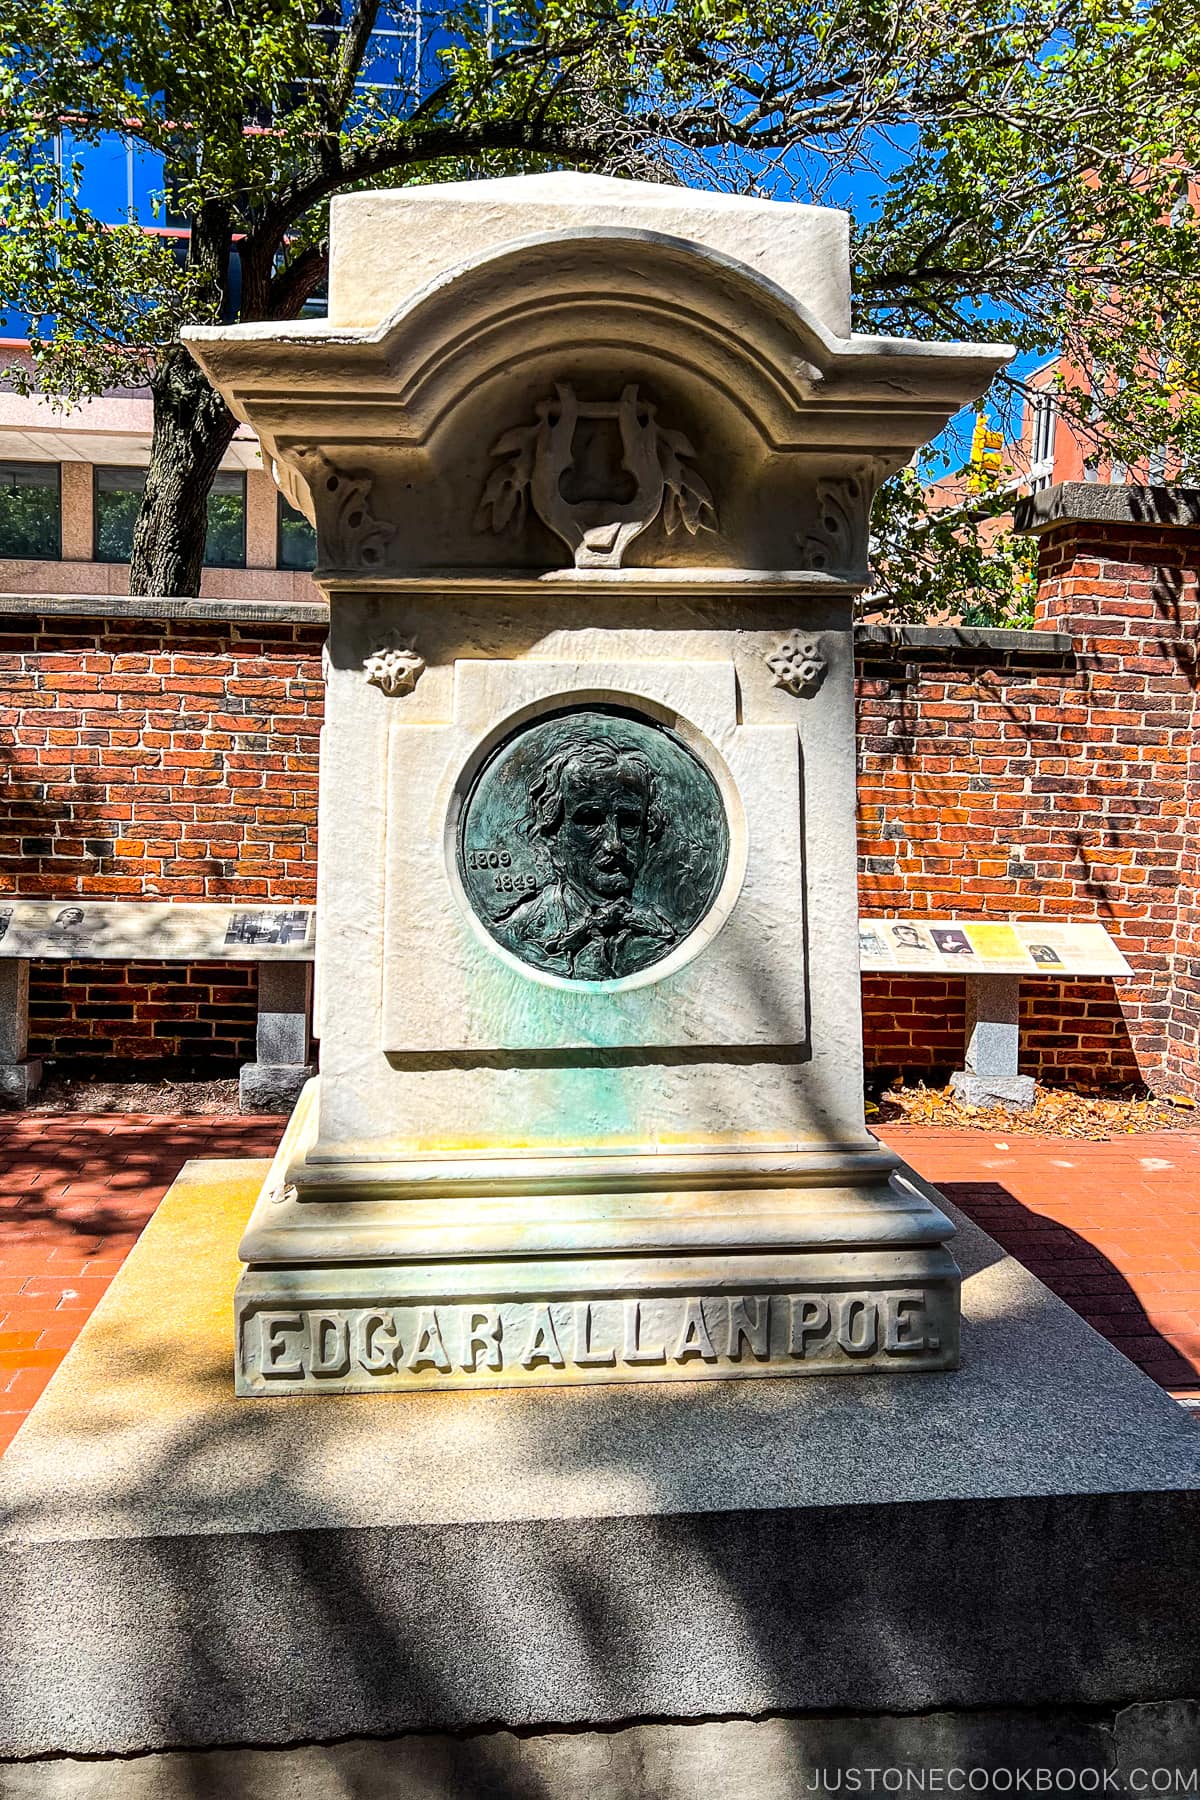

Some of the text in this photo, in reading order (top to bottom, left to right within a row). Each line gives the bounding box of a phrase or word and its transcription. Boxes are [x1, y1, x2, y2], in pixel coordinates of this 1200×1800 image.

[469, 851, 512, 870] 1809
[494, 873, 537, 892] 1849
[258, 1304, 503, 1378] EDGAR
[521, 1296, 771, 1371] ALLAN
